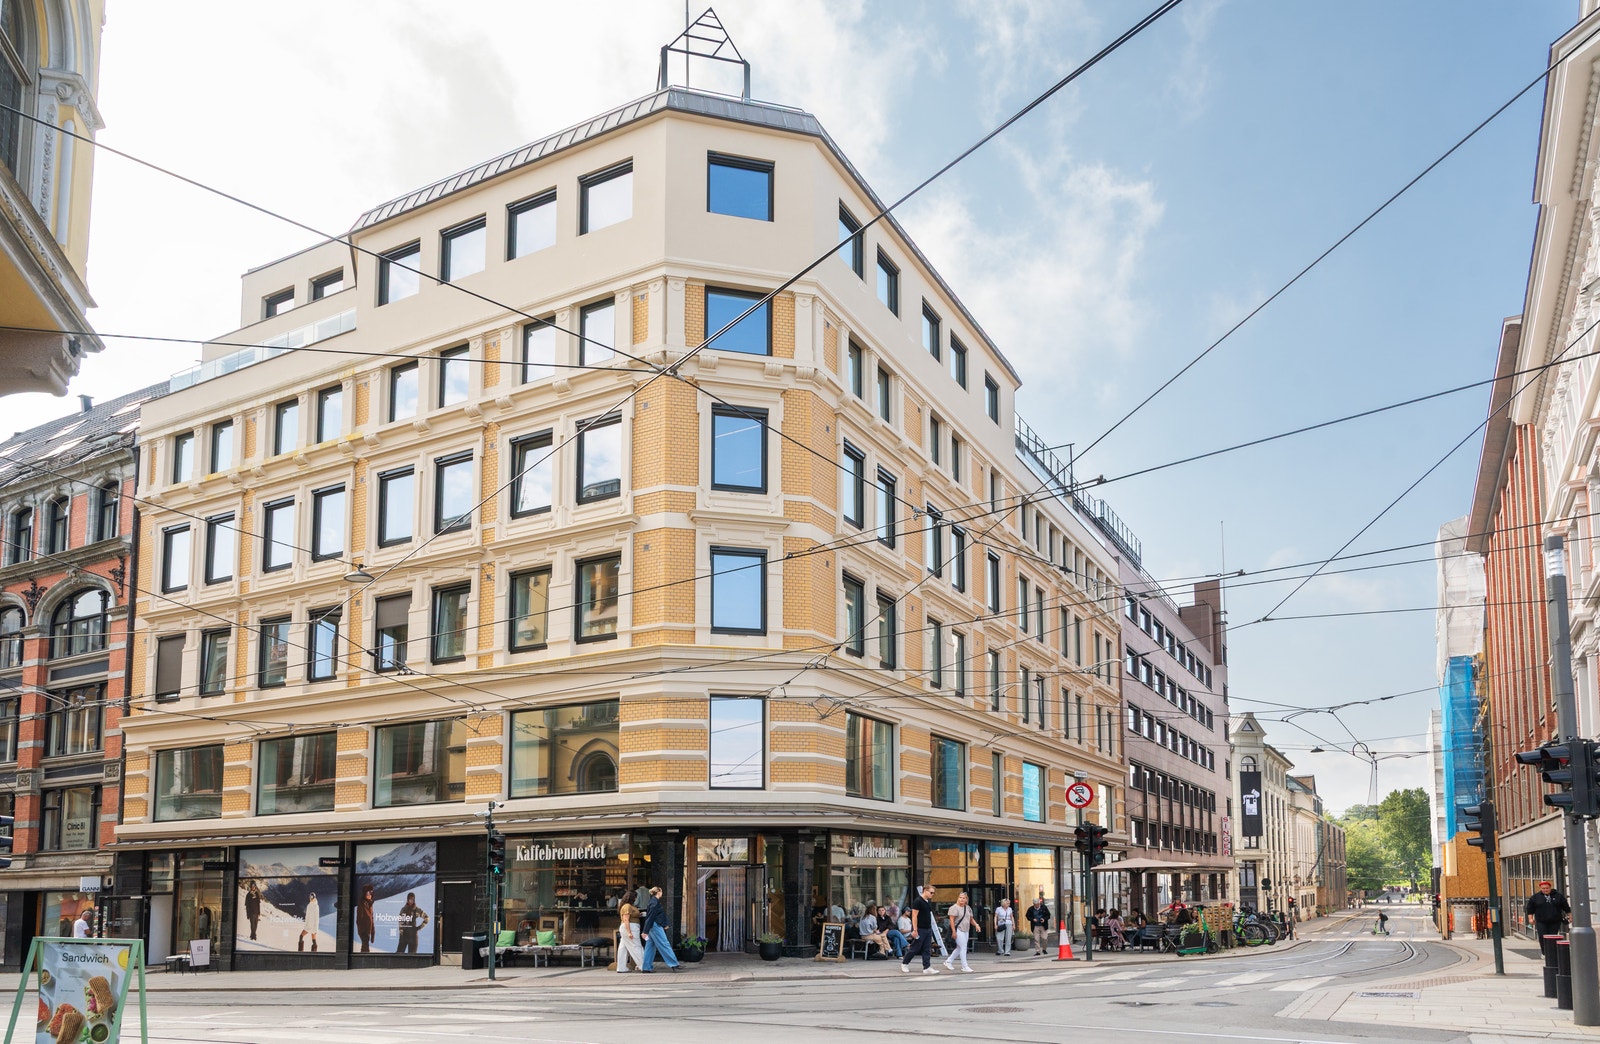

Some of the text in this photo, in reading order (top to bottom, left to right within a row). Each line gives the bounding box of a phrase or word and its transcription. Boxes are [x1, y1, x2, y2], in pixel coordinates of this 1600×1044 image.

[67, 822, 80, 831] Clinic
[516, 843, 606, 861] Kaffebrenneriet
[375, 913, 413, 922] Holzweiler
[62, 952, 109, 963] Sandwich
